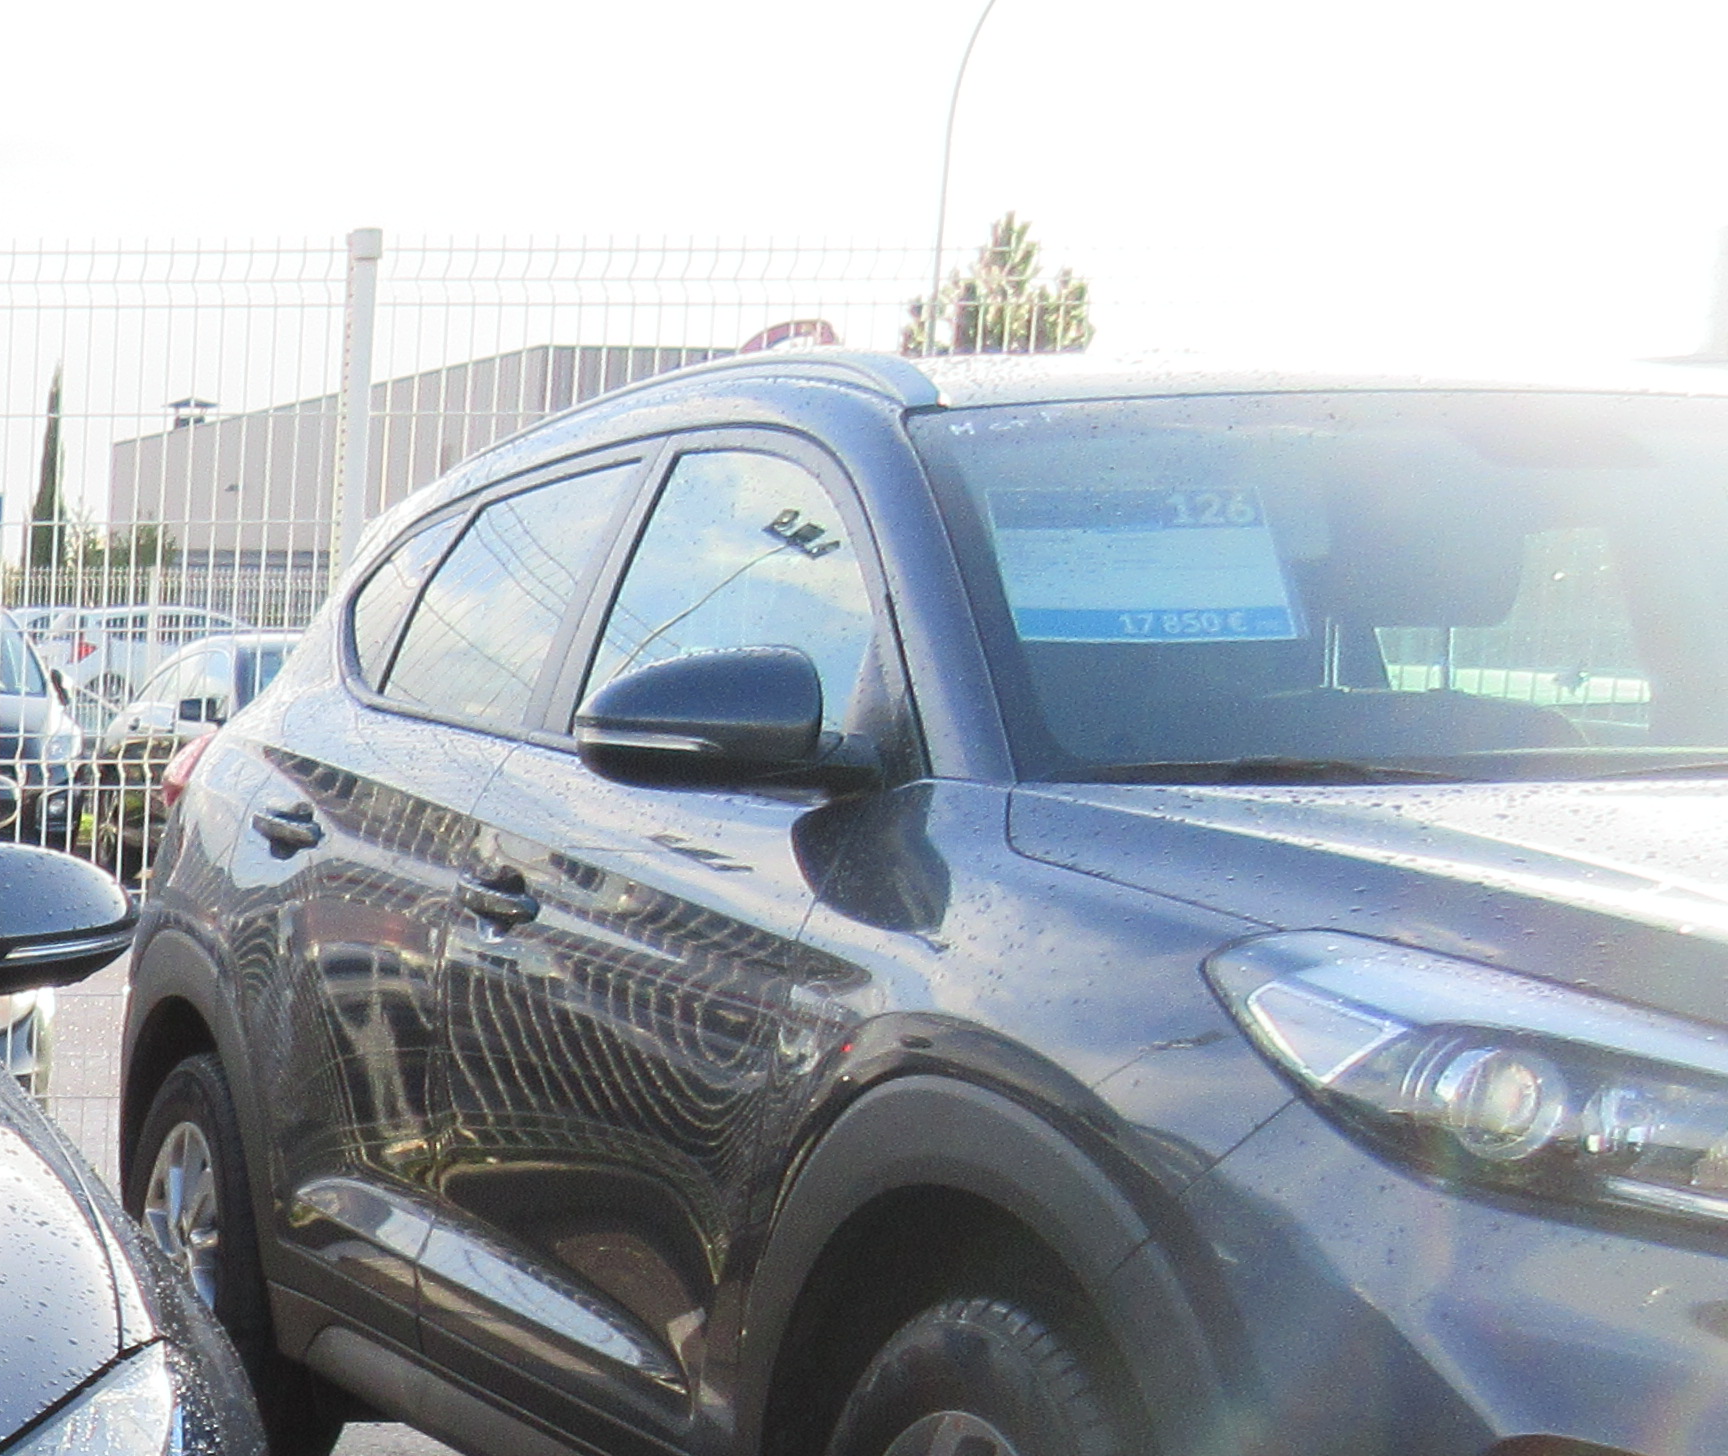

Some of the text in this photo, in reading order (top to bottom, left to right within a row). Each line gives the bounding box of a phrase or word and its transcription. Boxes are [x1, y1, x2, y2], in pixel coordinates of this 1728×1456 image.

[1166, 492, 1256, 525] 126
[1119, 613, 1153, 635] 17
[1162, 613, 1222, 635] 850
[1226, 613, 1248, 634] €
